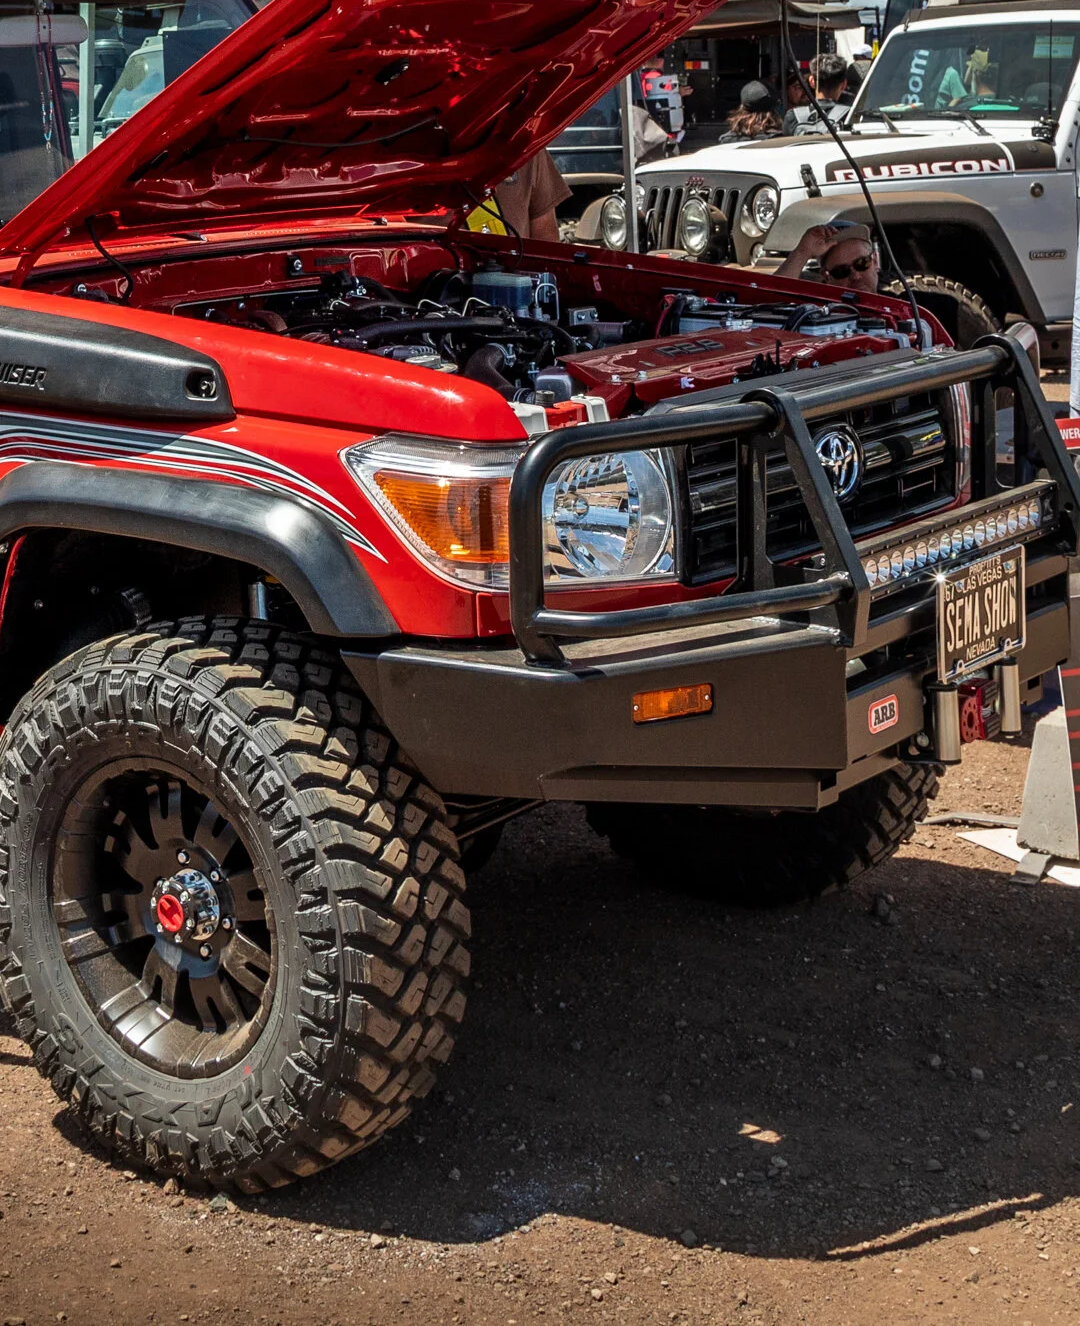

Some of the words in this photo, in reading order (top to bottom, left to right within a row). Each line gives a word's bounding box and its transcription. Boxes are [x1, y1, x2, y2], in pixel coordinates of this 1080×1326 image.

[832, 158, 1008, 182] RUBICON
[962, 575, 977, 593] LAS
[977, 566, 1003, 587] VEGAS
[946, 592, 980, 652] SEMA
[984, 576, 1017, 636] SHOW
[966, 636, 996, 660] NEVADA
[873, 701, 896, 727] ARB
